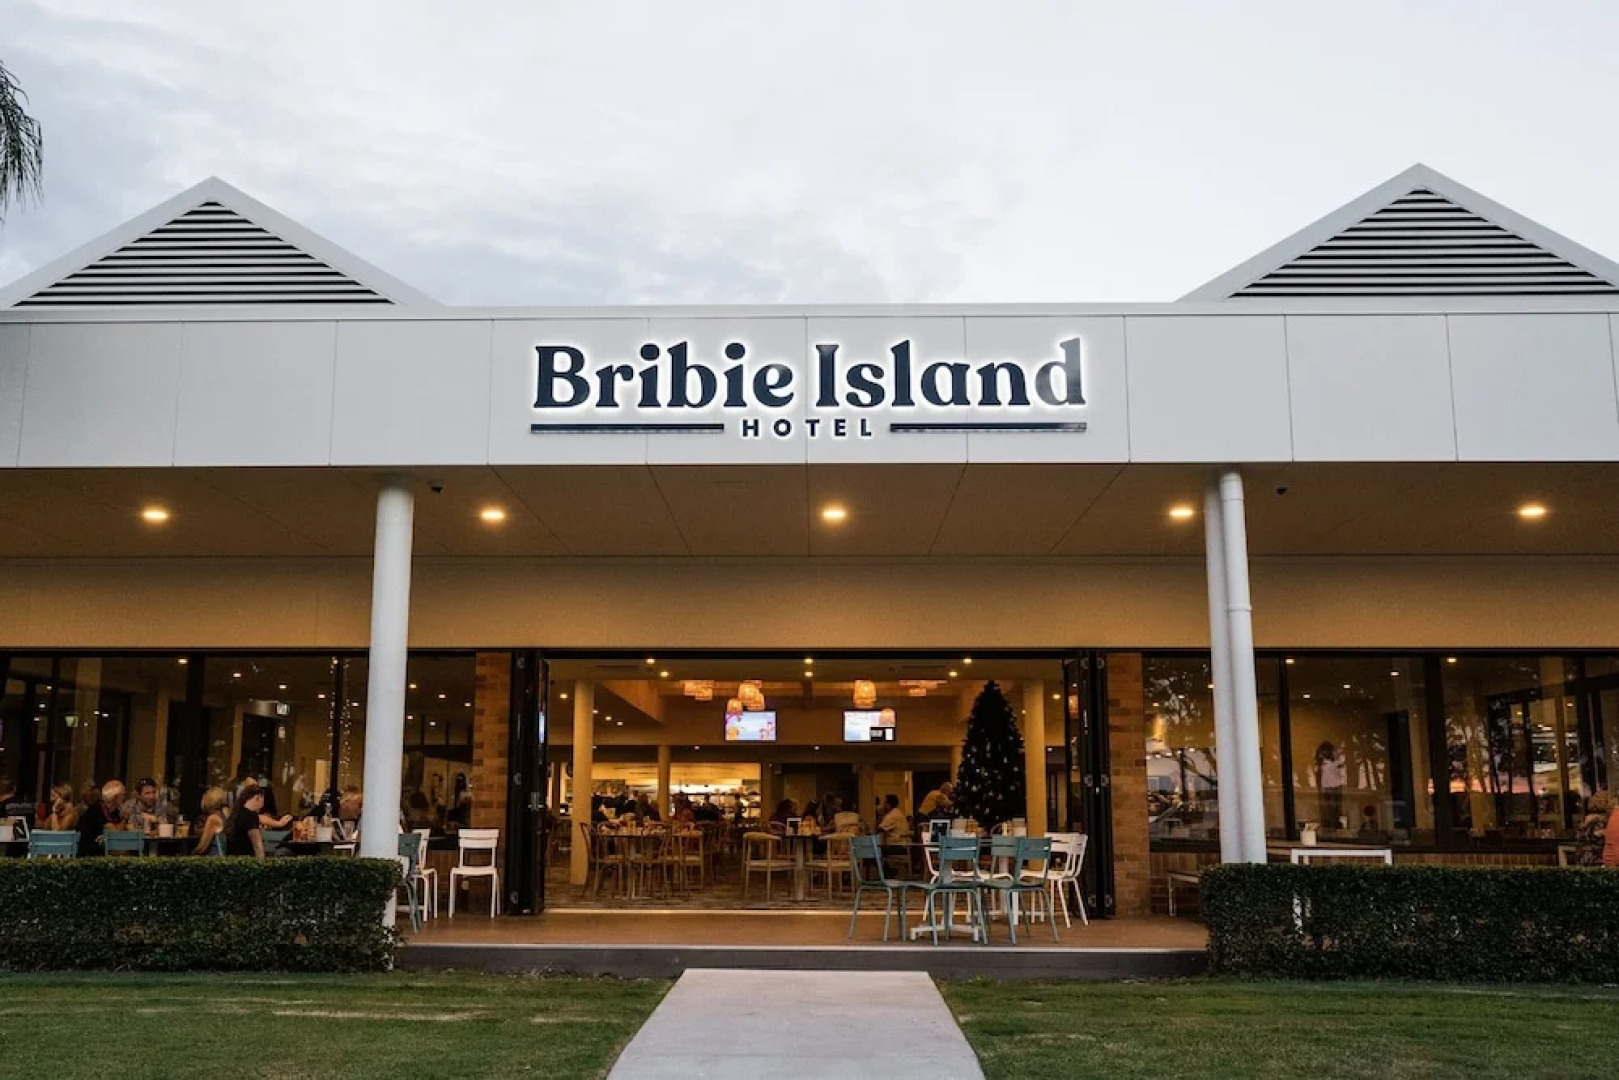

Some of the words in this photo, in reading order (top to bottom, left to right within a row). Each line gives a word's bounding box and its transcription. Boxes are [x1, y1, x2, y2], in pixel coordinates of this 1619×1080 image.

[533, 340, 794, 409] Bribie
[814, 337, 1087, 408] Island
[741, 418, 873, 438] HOTEL
